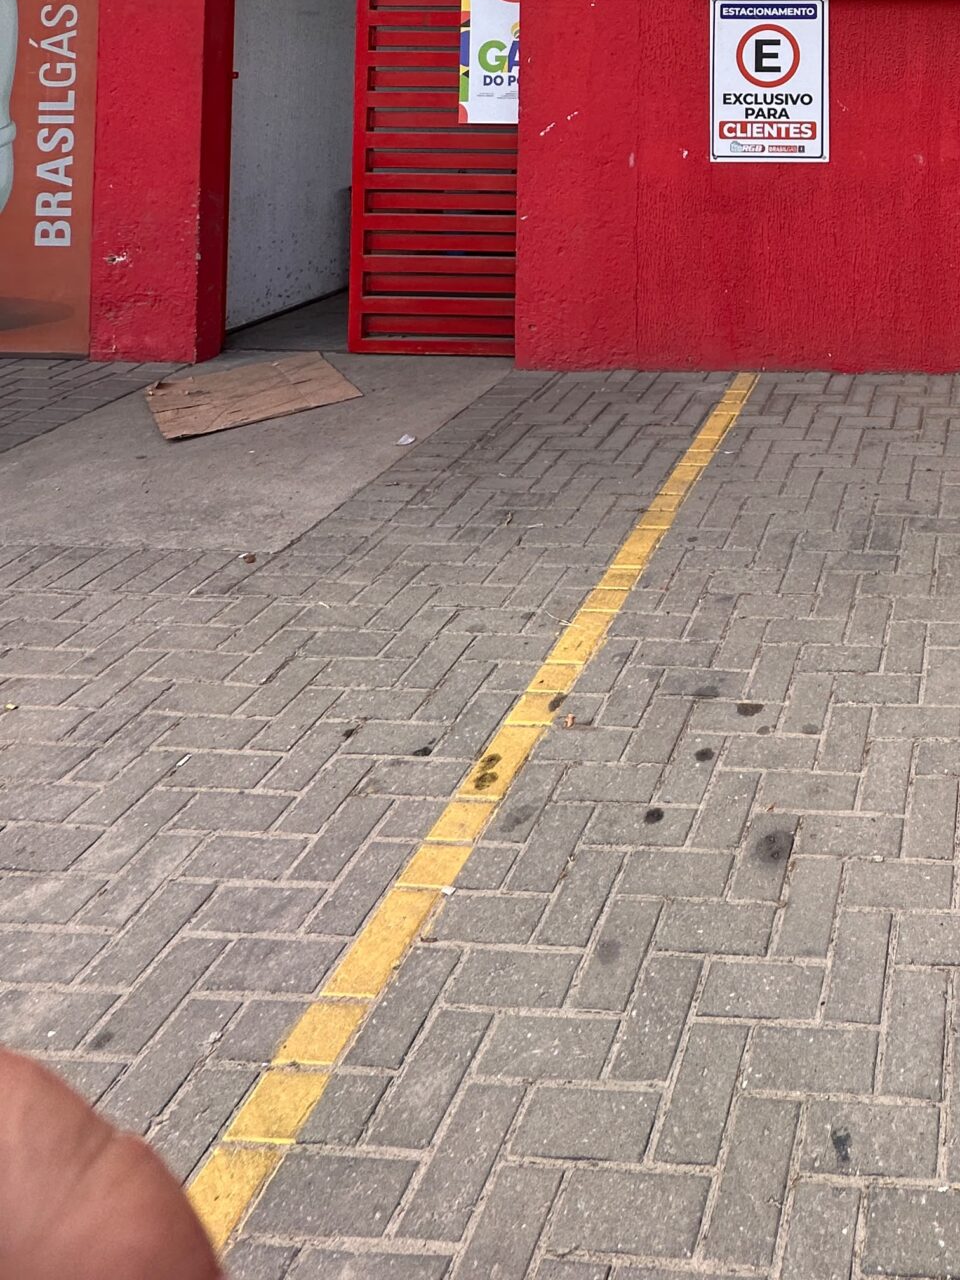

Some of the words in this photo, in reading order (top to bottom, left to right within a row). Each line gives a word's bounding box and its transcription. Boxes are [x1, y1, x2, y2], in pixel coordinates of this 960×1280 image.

[722, 7, 815, 17] ESTACIONAMENTO
[754, 39, 781, 73] E
[483, 75, 504, 86] DO
[722, 93, 813, 106] EXCLUSIVO
[744, 107, 790, 119] PARA
[28, 3, 79, 248] BRASILGÁS
[723, 123, 813, 138] CLIENTES
